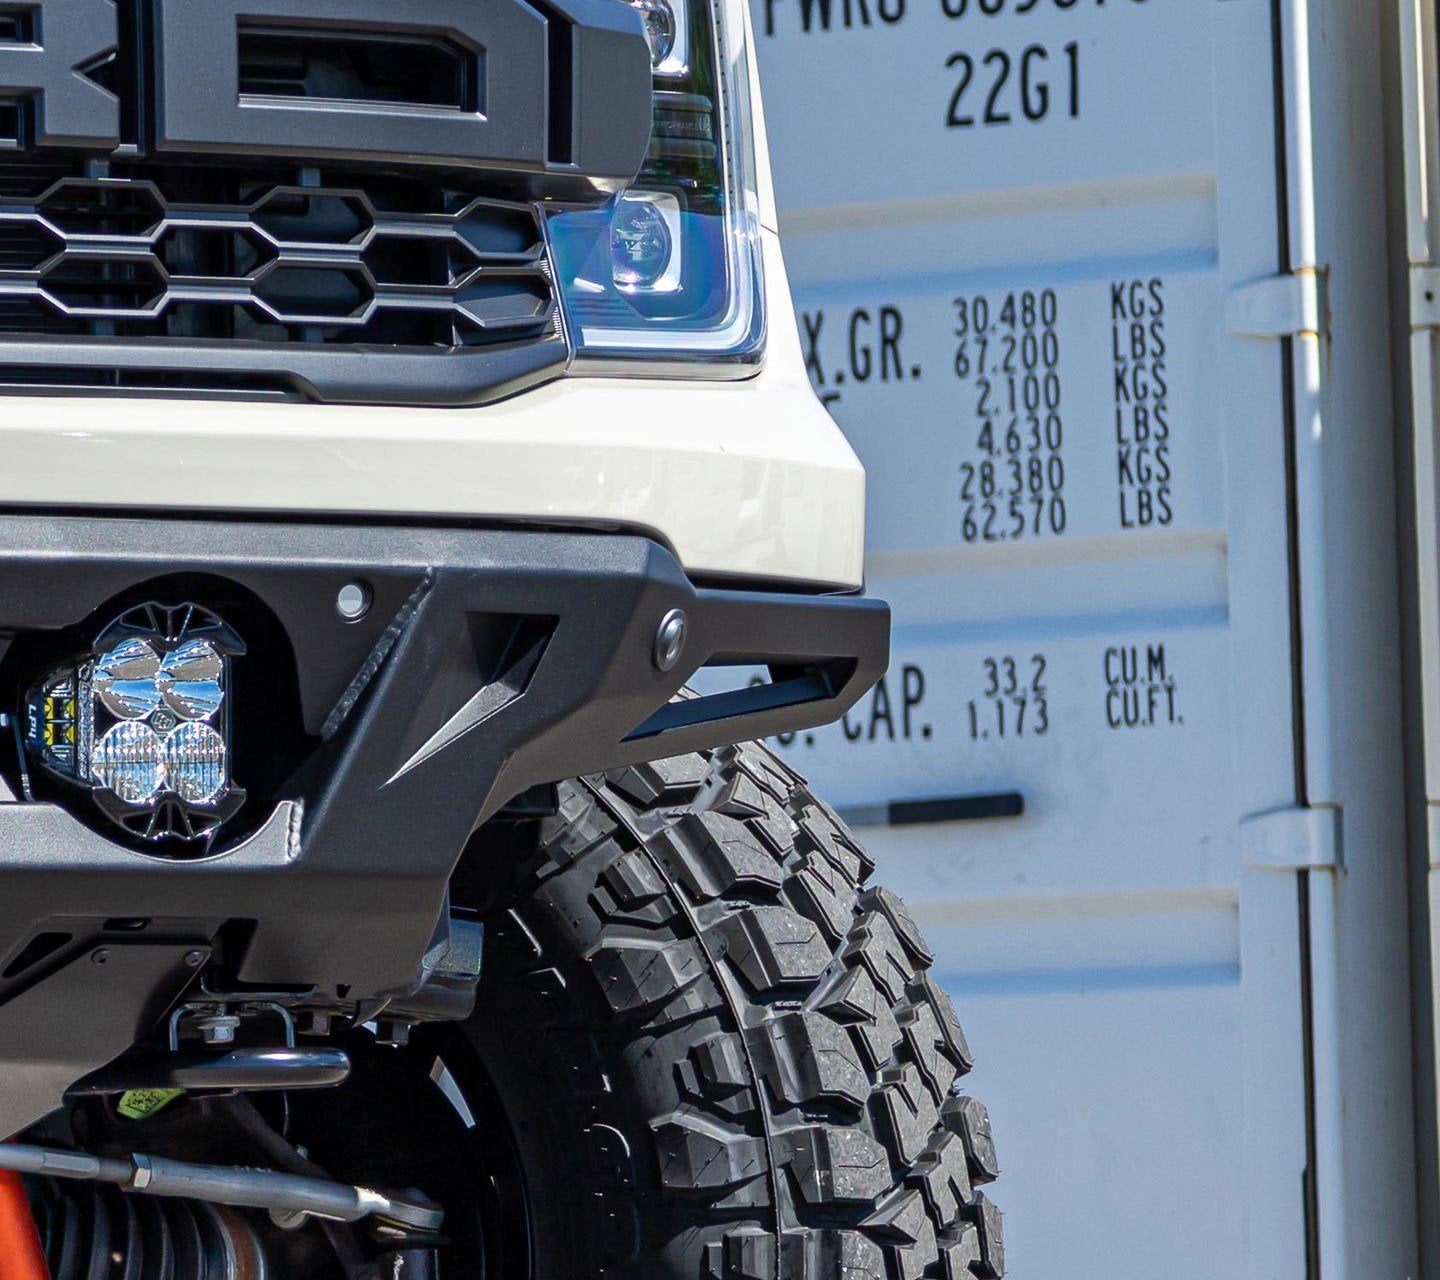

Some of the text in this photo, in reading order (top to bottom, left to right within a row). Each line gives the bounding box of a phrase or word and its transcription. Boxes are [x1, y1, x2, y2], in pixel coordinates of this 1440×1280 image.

[944, 40, 1082, 128] 22G1
[952, 287, 1058, 338] 30.480
[1110, 277, 1165, 321] KGS
[954, 320, 1166, 379] 67.200 LBS
[975, 362, 1169, 419] 2.100 KGS
[976, 403, 1170, 457] 4.630 LBS
[958, 444, 1172, 502] 28.380 KGS
[961, 487, 1174, 545] 62.570 LBS
[27, 703, 37, 739] LP4
